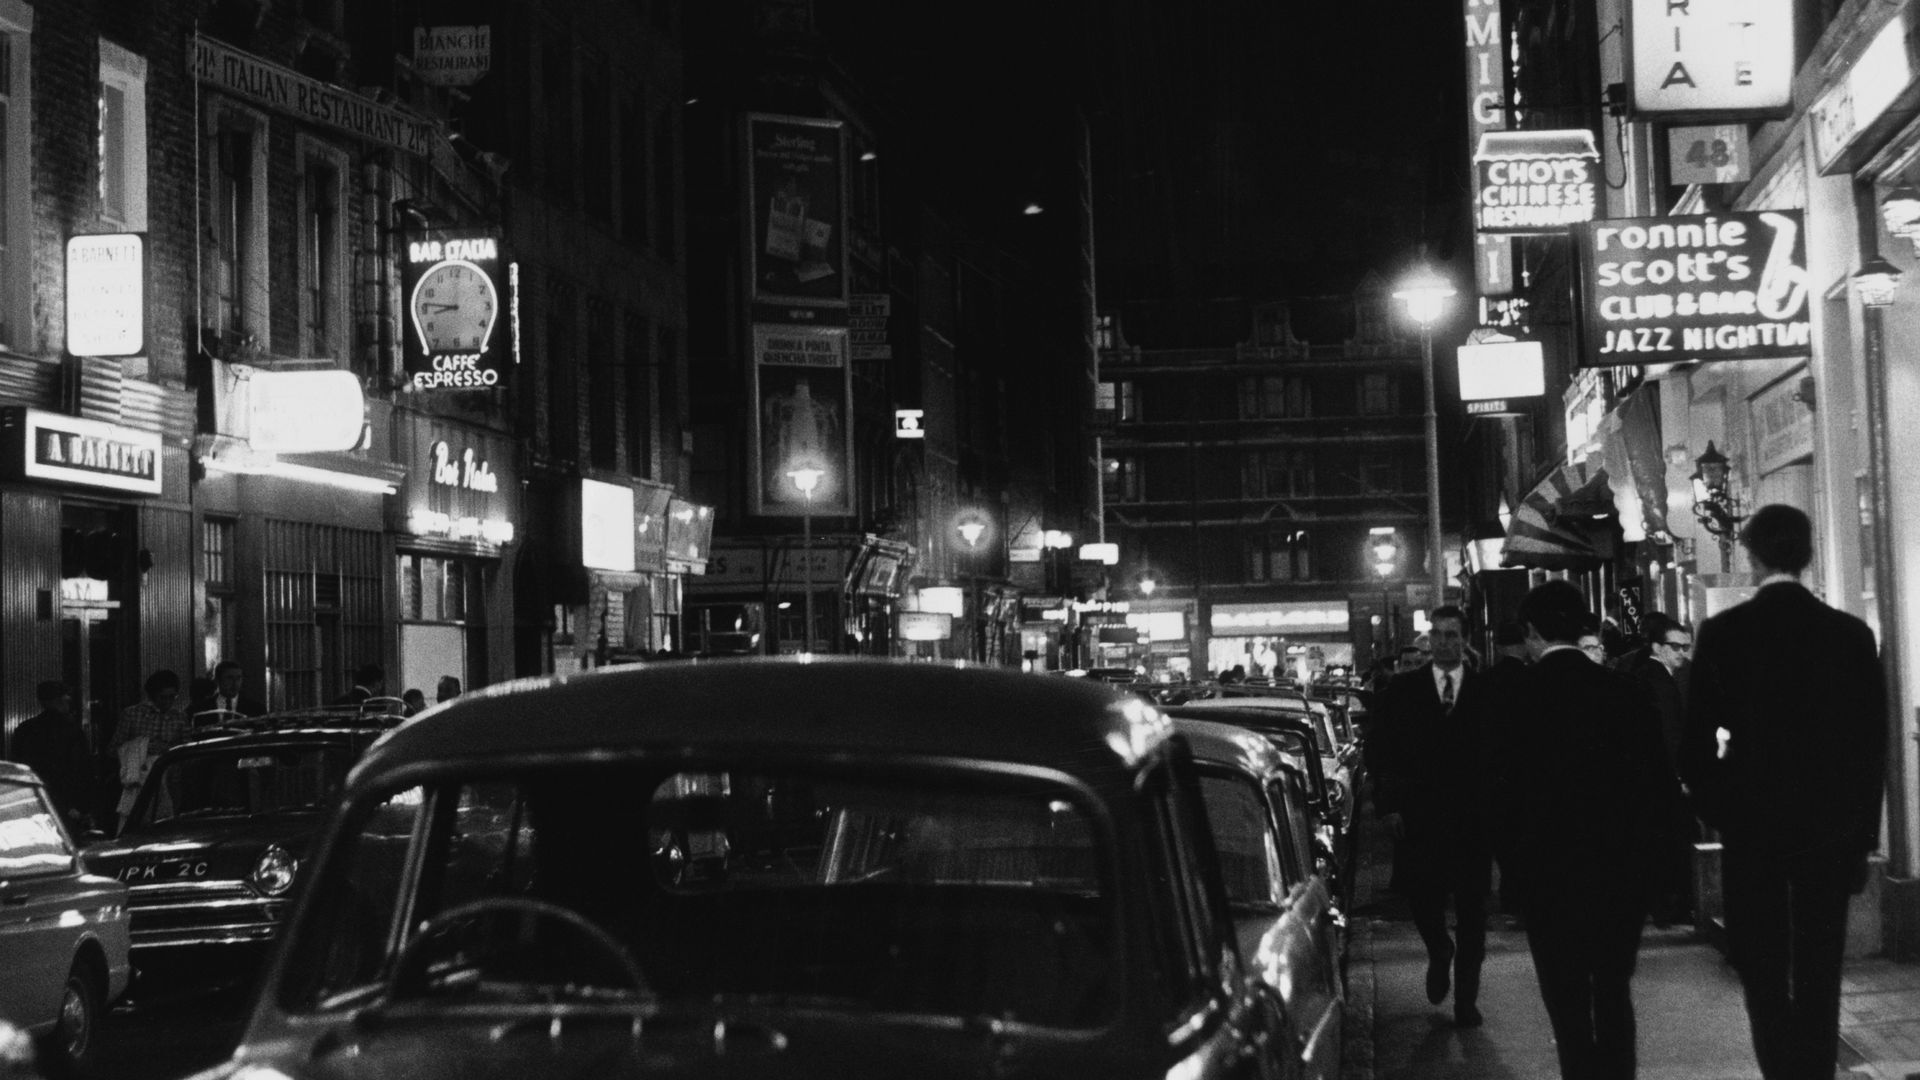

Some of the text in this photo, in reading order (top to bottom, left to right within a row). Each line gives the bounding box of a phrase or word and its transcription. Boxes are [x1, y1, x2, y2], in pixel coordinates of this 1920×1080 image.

[223, 54, 289, 106] ITALIAN
[298, 80, 404, 148] RESTAURANT
[1686, 139, 1730, 169] 48
[1482, 183, 1596, 206] CHINESE
[1596, 216, 1747, 250] ronnie
[409, 237, 498, 264] BAR ITALIA
[1597, 250, 1751, 287] scott's
[1600, 290, 1757, 321] CLUB & BAR
[1599, 327, 1675, 354] JAZZ
[413, 368, 499, 389] ESPRESSO
[1466, 401, 1508, 414] SPIRITS
[435, 441, 459, 487] Bar
[178, 862, 208, 877] 2C
